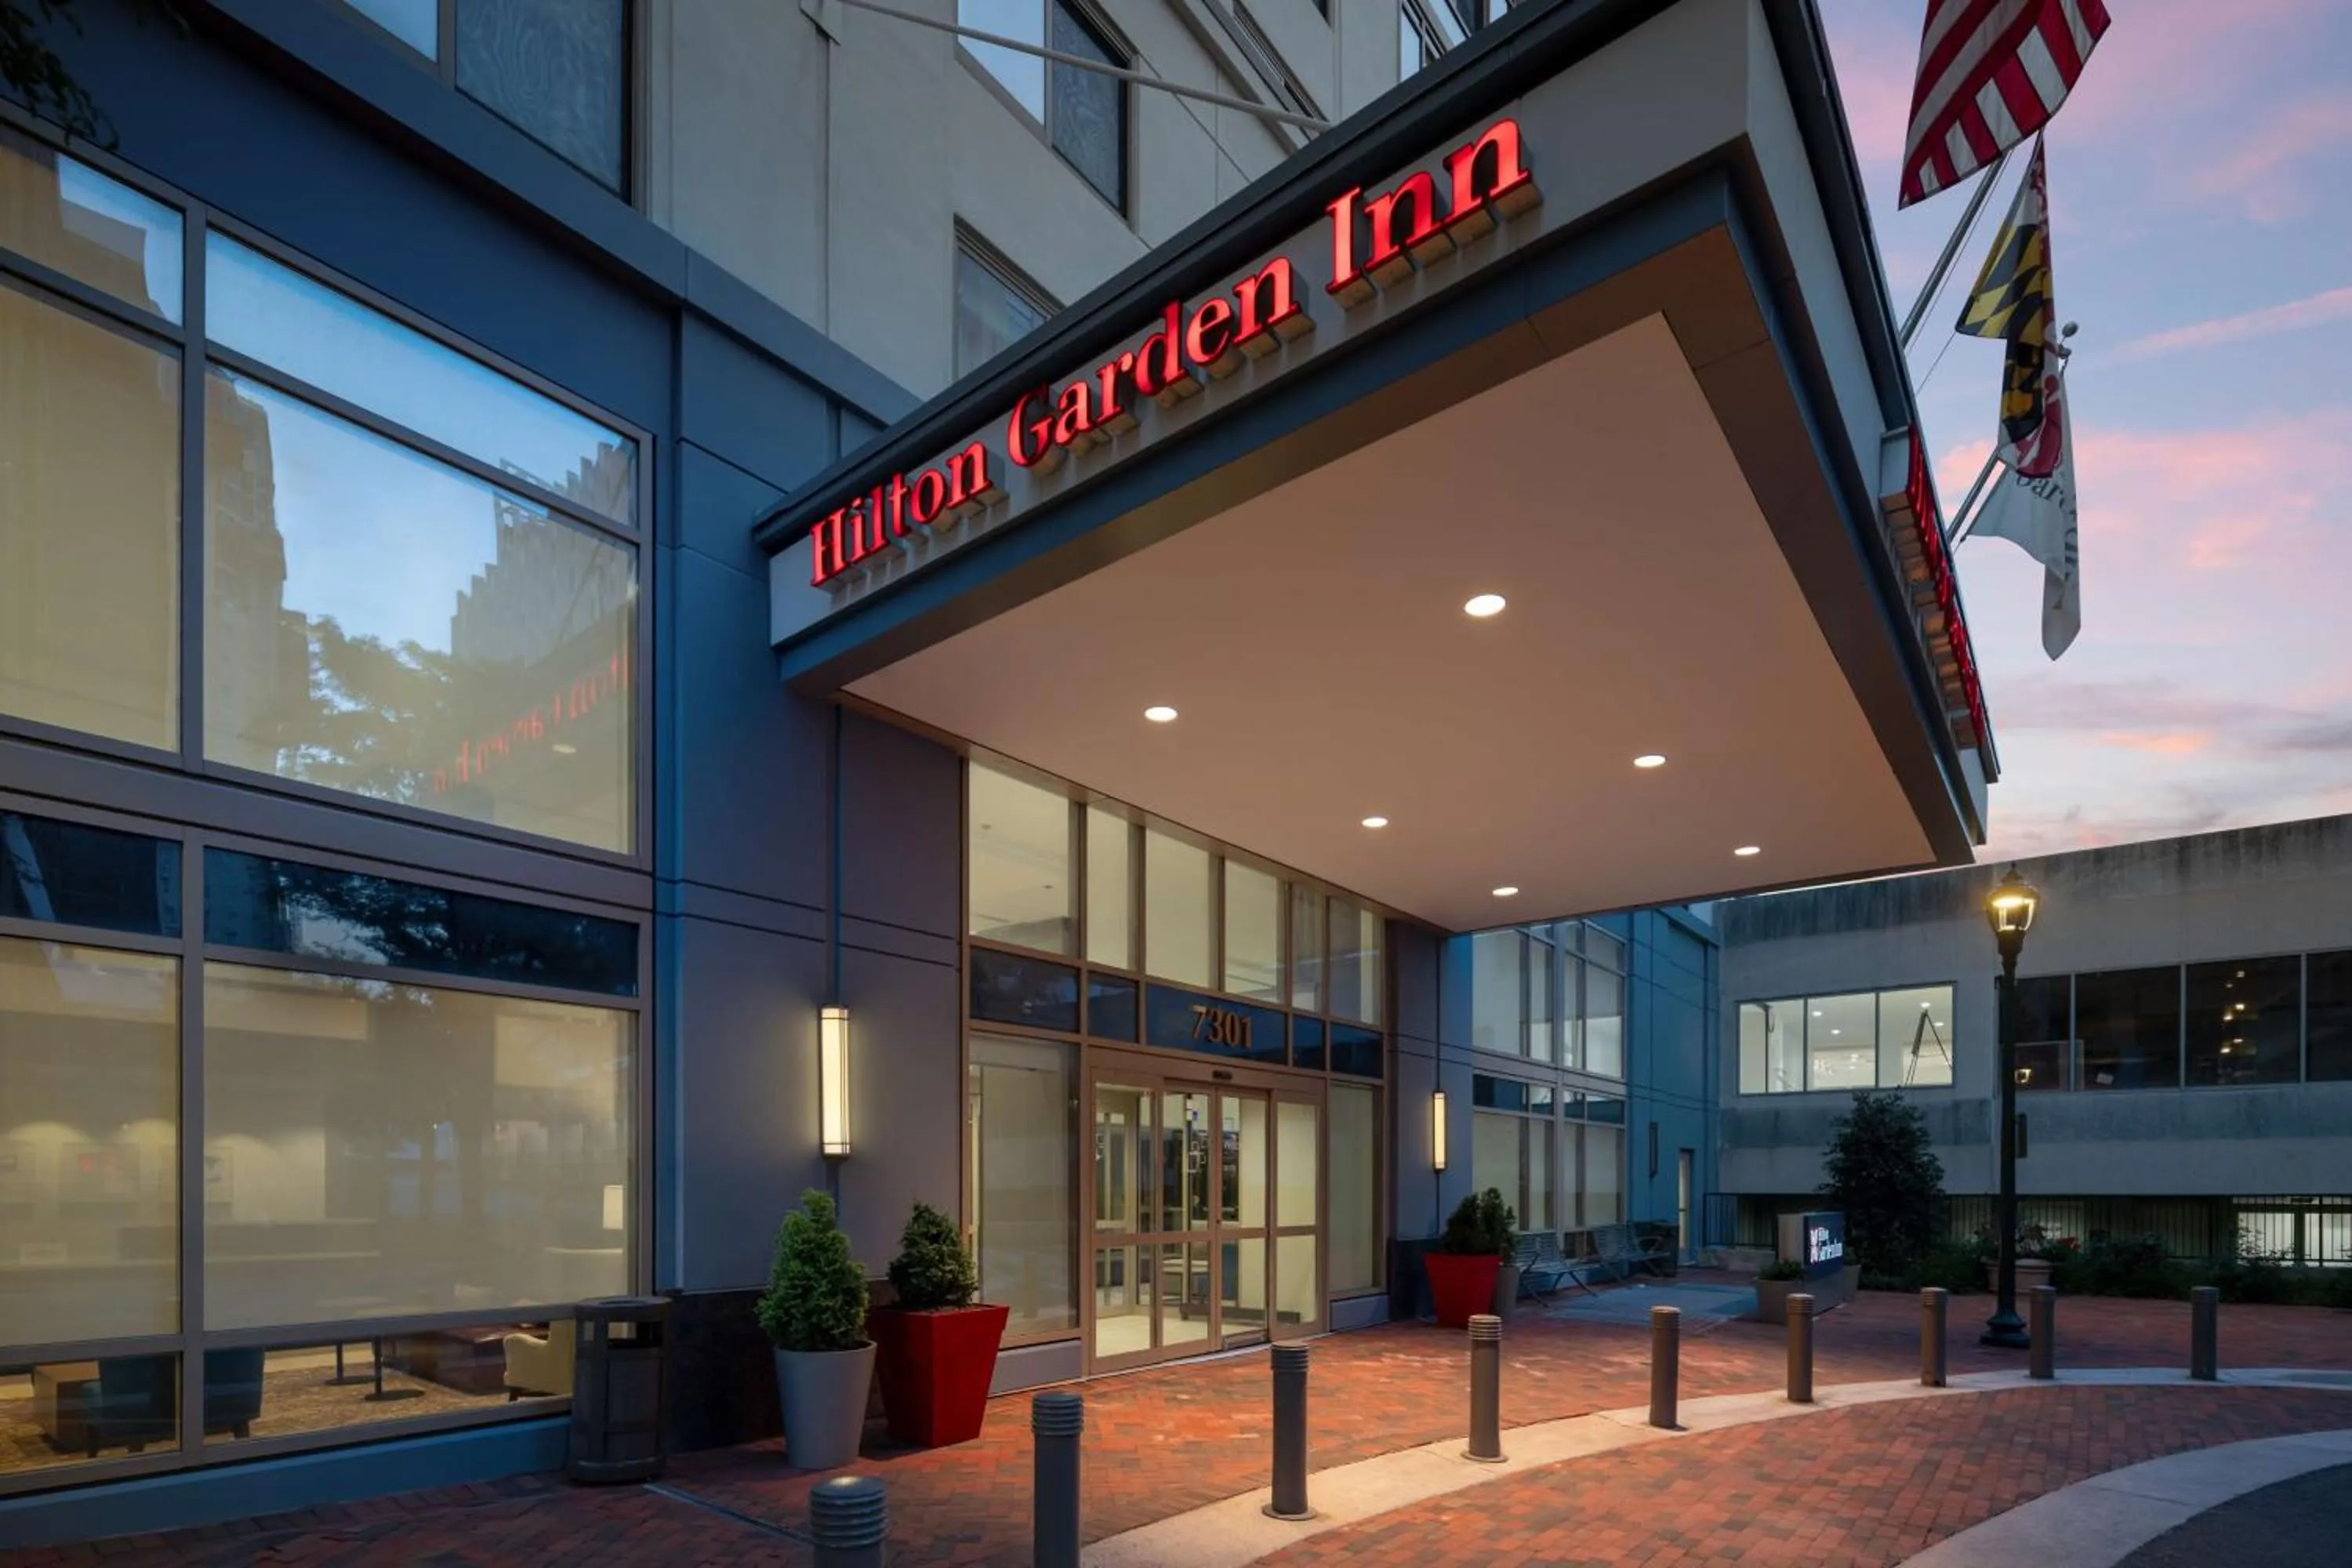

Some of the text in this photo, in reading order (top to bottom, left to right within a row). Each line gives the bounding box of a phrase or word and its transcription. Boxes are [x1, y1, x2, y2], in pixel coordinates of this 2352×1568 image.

[809, 118, 1531, 589] Hilton Garden Inn
[1189, 1004, 1252, 1051] 7301
